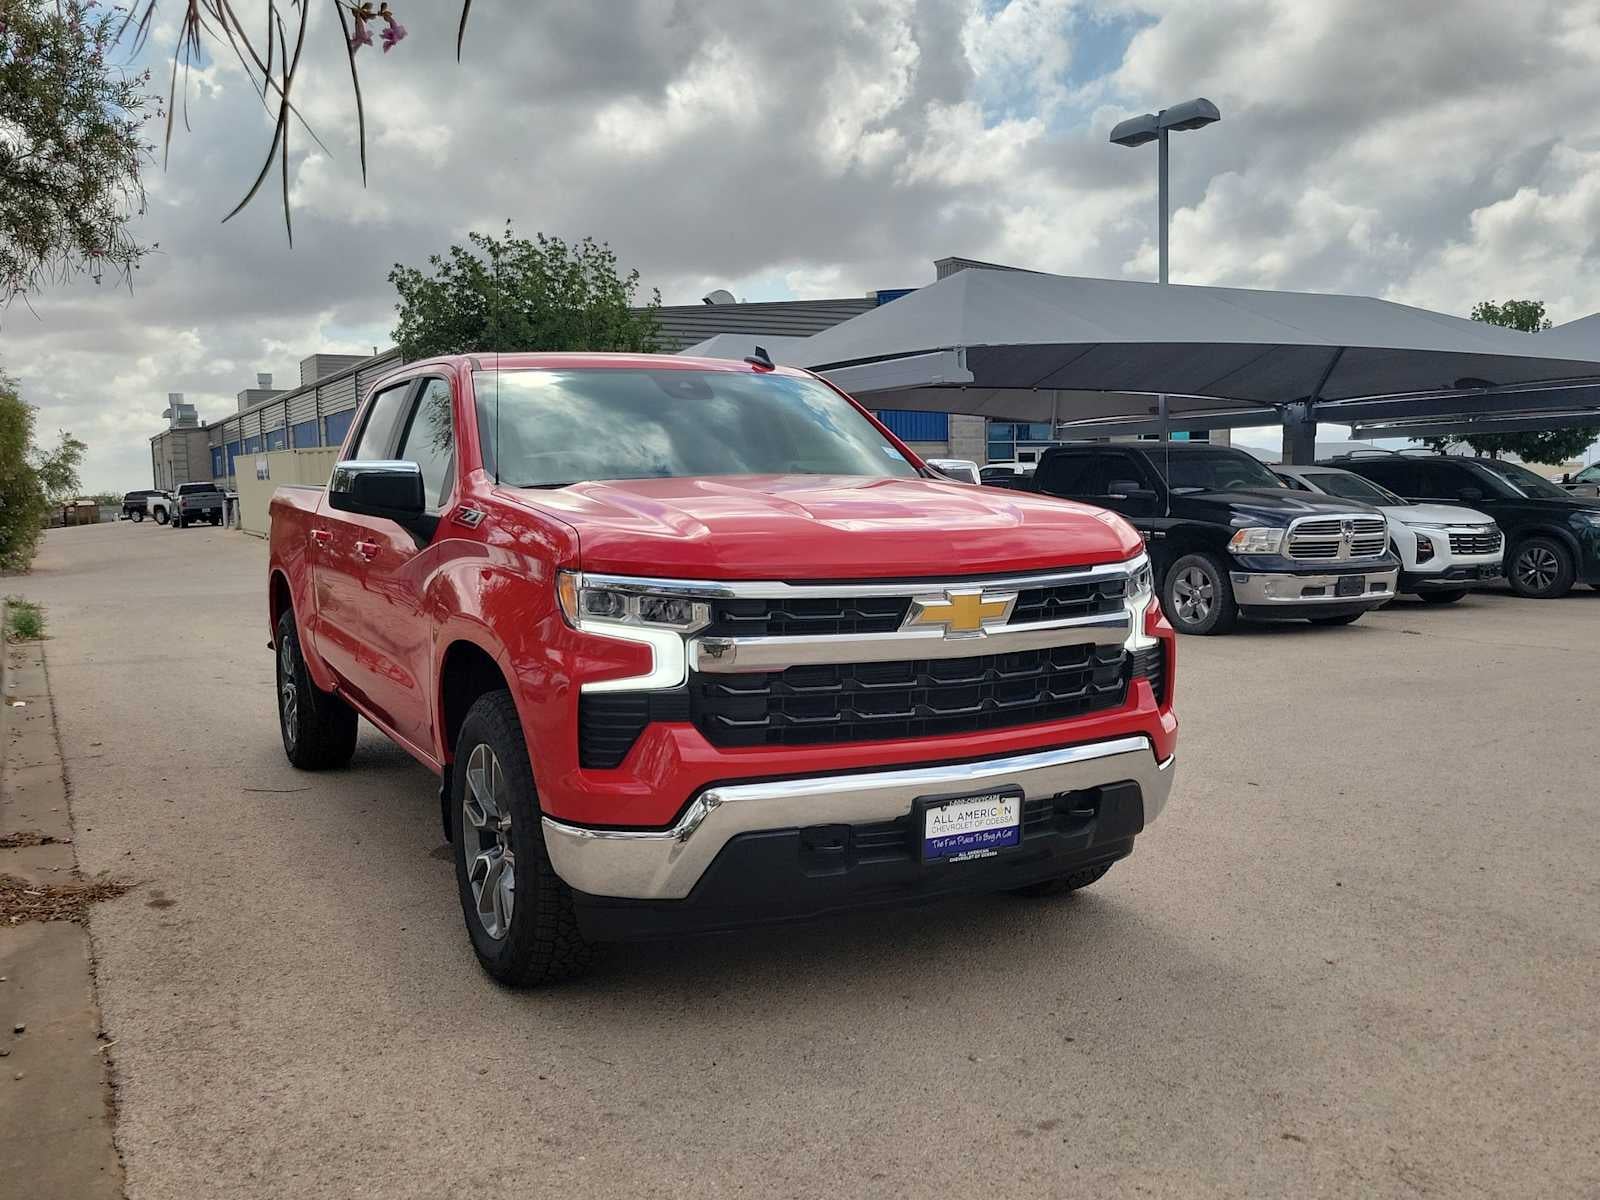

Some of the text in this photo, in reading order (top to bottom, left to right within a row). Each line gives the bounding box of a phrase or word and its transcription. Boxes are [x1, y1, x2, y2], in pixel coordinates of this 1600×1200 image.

[932, 821, 973, 833] CHEVROLET
[986, 816, 1014, 826] ODESSA
[934, 813, 953, 824] ALL
[932, 840, 944, 848] The
[956, 835, 974, 846] Place
[975, 834, 983, 842] To
[982, 832, 996, 843] Buy
[1002, 830, 1013, 838] Car
